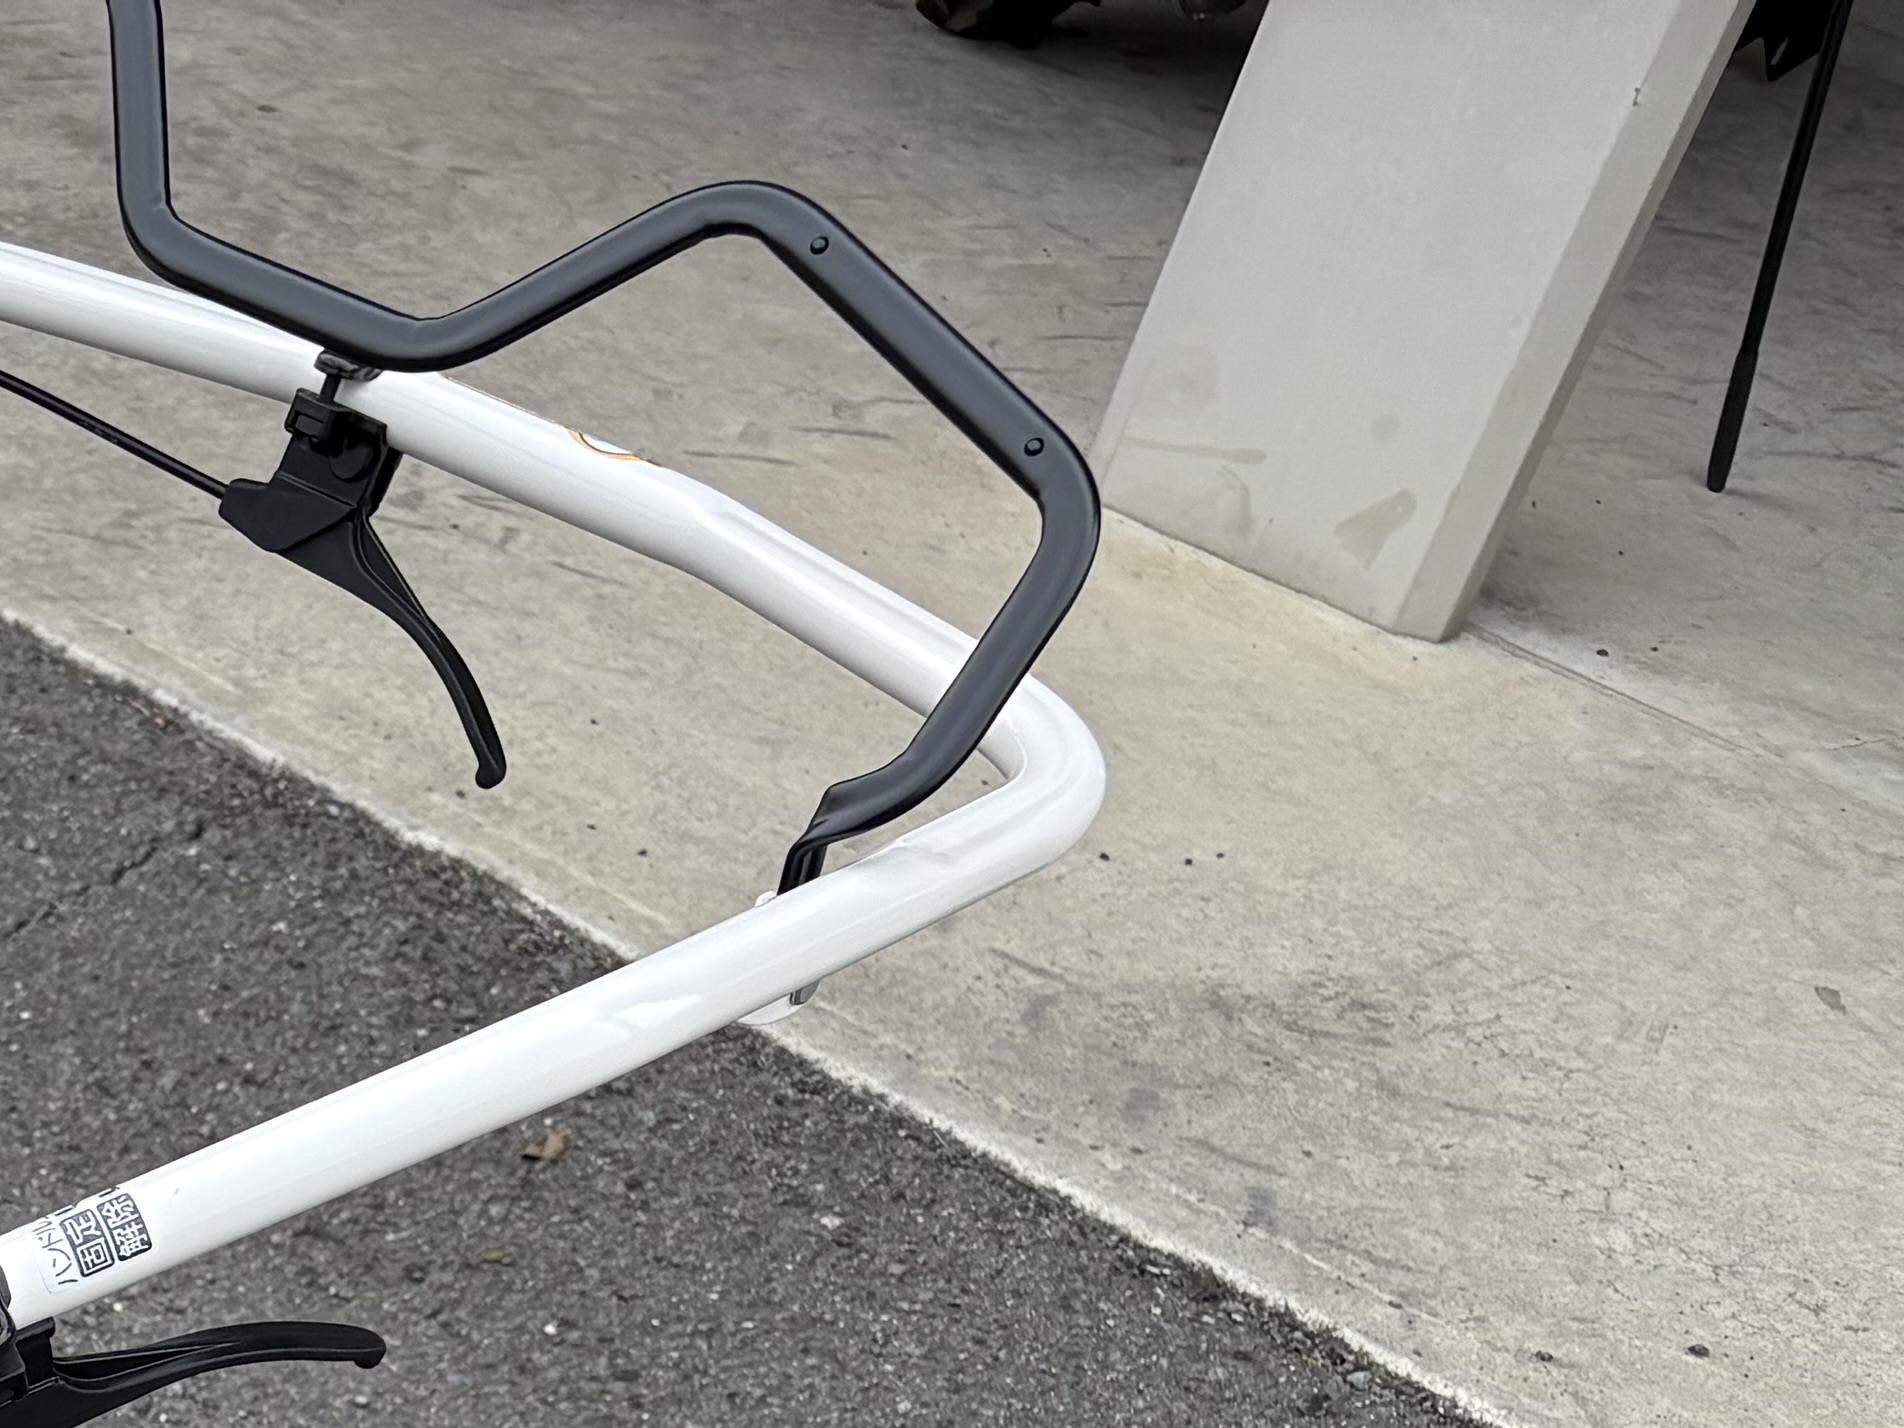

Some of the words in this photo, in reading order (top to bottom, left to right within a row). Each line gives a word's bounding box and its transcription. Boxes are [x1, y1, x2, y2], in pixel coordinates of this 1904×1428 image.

[31, 1213, 79, 1285] ハンドル
[64, 1210, 113, 1275] 固定
[99, 1196, 150, 1259] 解除
